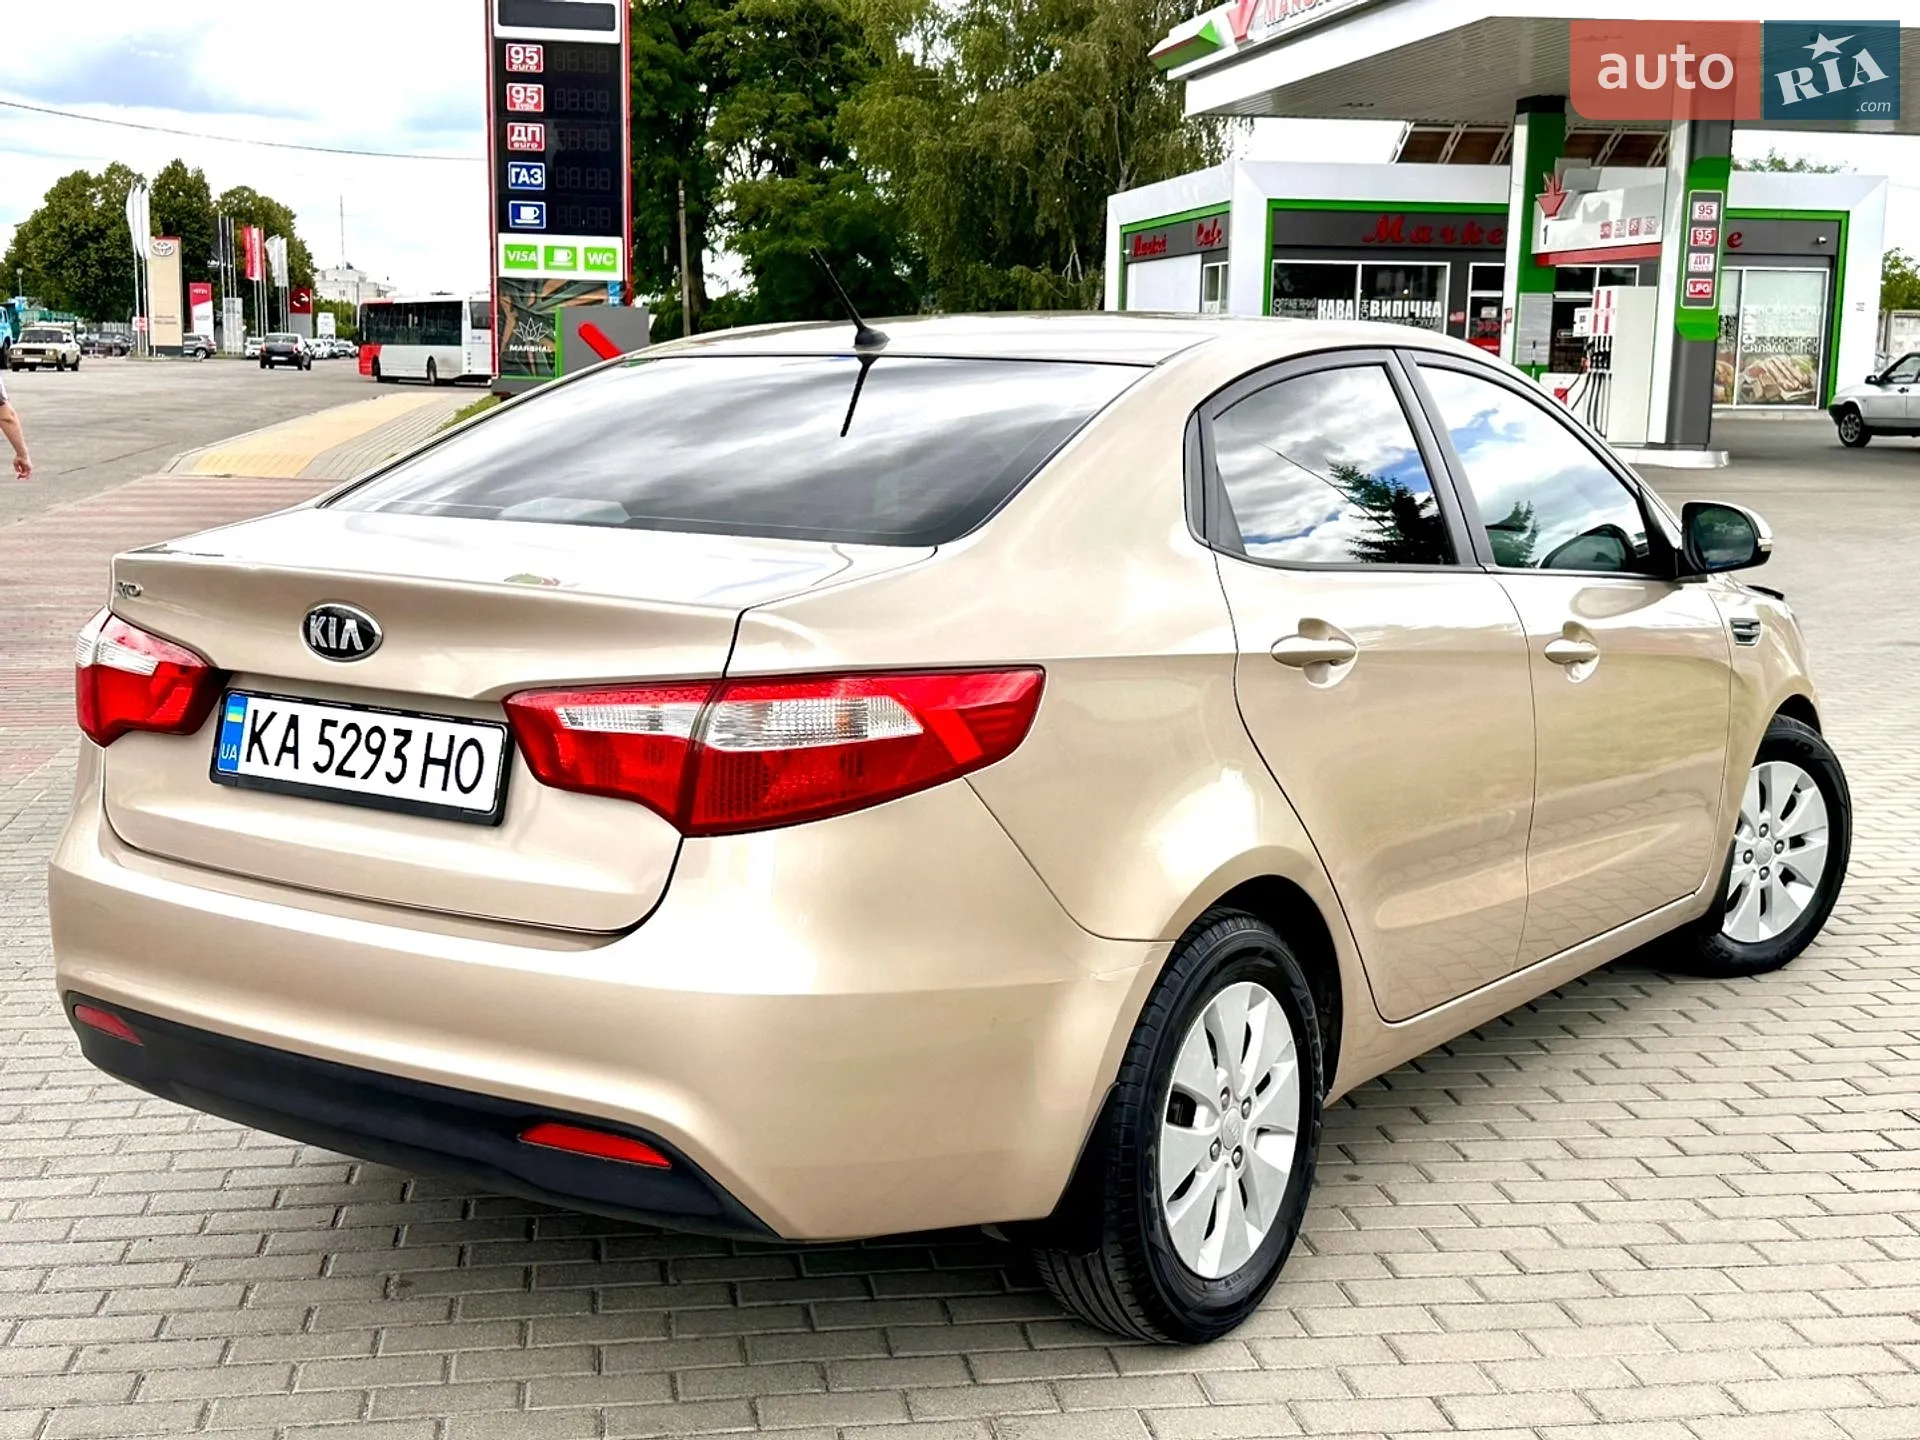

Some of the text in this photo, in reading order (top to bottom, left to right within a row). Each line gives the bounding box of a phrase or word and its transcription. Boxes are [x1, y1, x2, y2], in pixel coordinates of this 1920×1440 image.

[510, 46, 539, 65] 95
[511, 86, 539, 105] 95
[511, 126, 540, 142] ДП
[511, 167, 542, 185] ГАЗ
[1698, 204, 1714, 215] 95
[1361, 215, 1505, 245] Marke
[1542, 225, 1549, 245] 1
[1695, 230, 1713, 241] 95
[506, 250, 615, 265] VISA WC
[1317, 299, 1354, 320] КАВА
[1370, 300, 1442, 317] ВИПІЧКА
[309, 615, 364, 651] KIA
[221, 743, 238, 760] UA
[246, 709, 485, 795] KA 5293 HO
